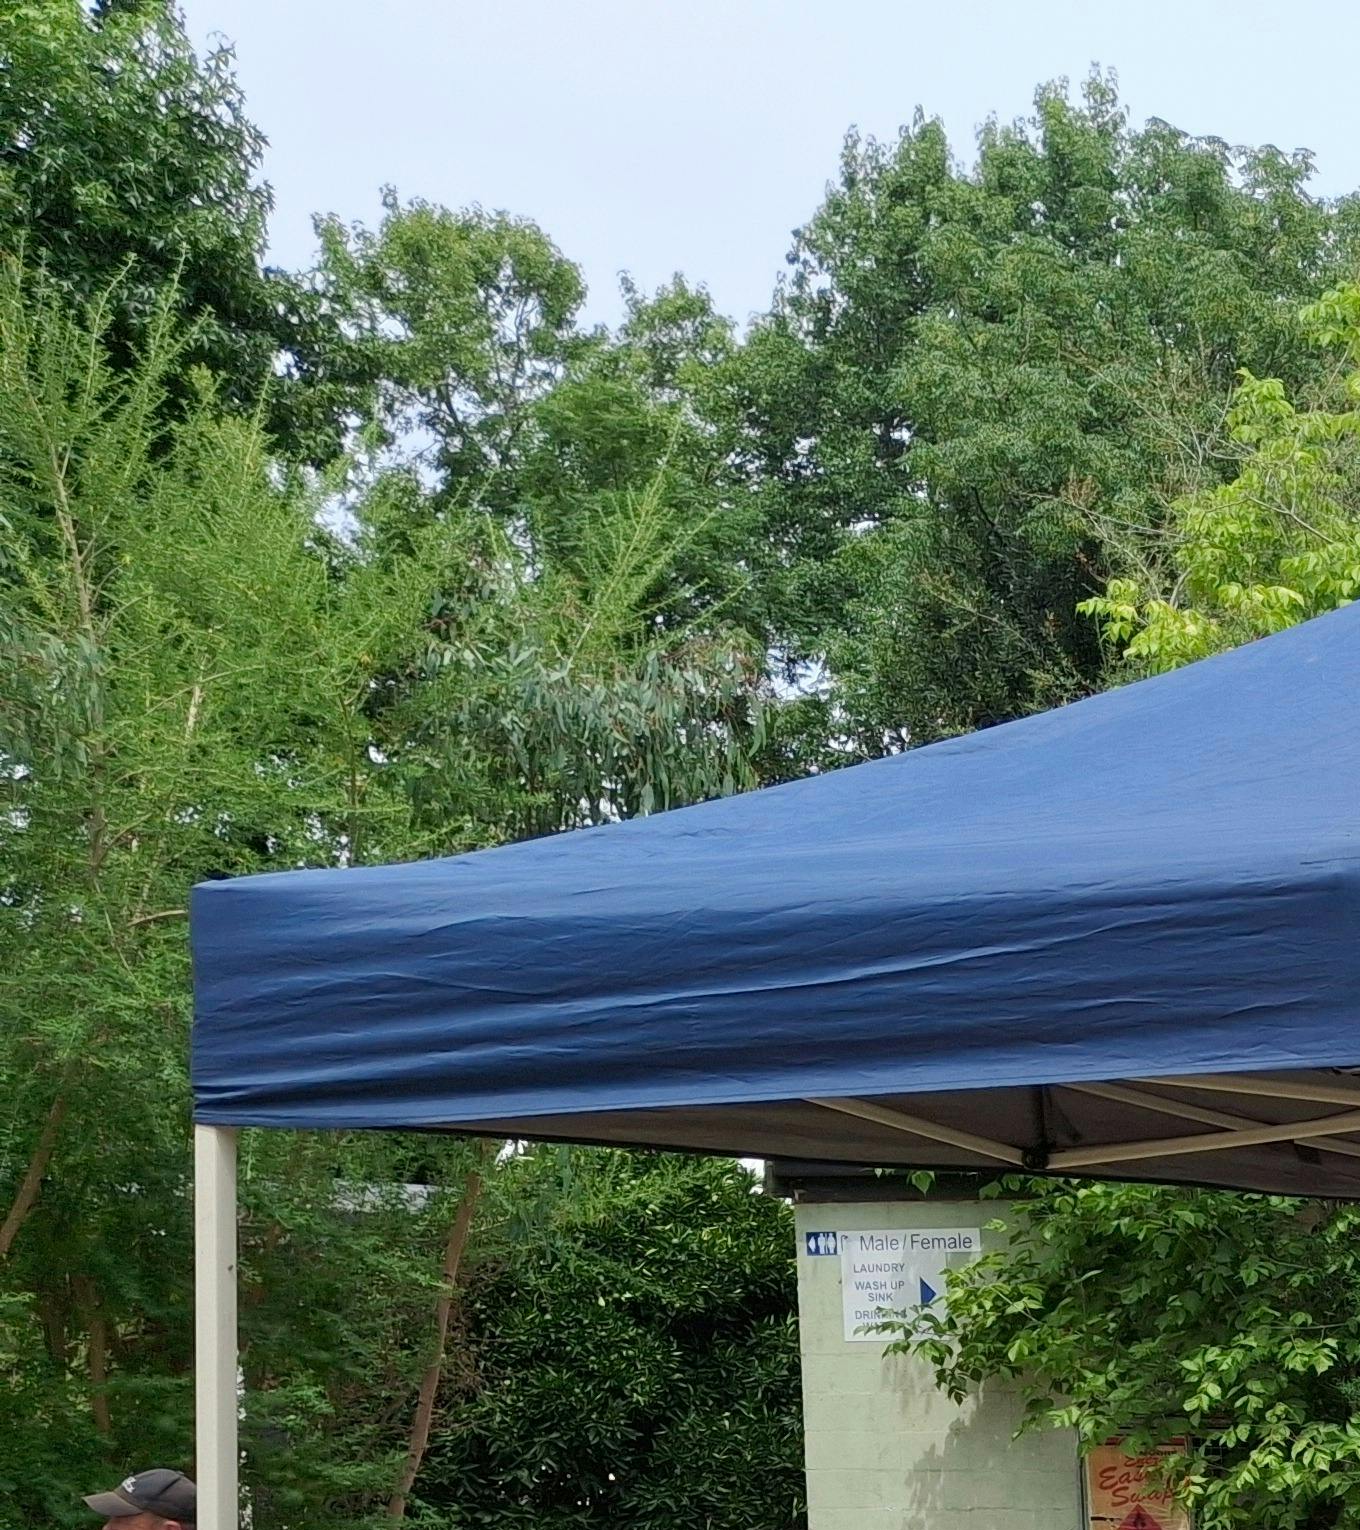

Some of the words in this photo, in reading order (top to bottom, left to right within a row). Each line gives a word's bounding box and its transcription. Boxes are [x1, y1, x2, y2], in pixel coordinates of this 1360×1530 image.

[860, 1234, 899, 1252] Male
[910, 1232, 973, 1250] Female
[853, 1263, 905, 1273] LAUNDRY
[854, 1281, 888, 1291] WASH
[890, 1280, 905, 1290] UP
[868, 1292, 894, 1302] SINK
